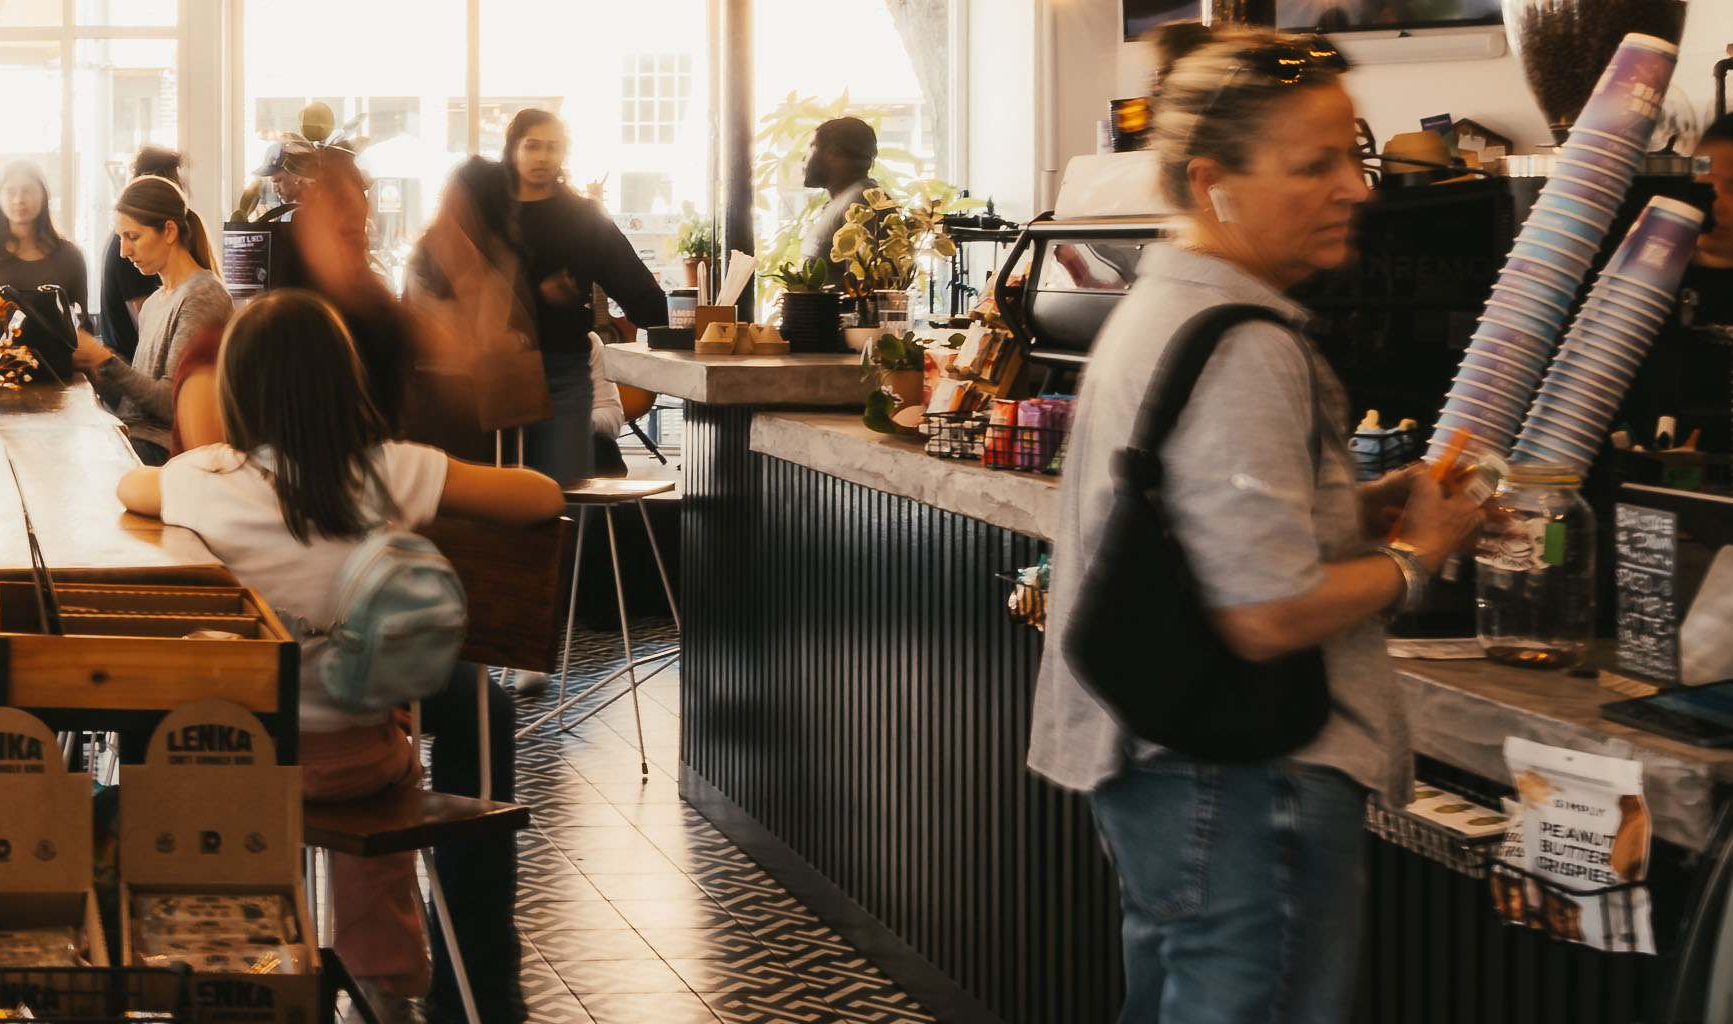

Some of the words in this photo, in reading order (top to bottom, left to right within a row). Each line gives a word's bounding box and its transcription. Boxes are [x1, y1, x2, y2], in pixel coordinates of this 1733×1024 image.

[167, 724, 253, 753] LENKA
[1540, 821, 1618, 849] PEANUT
[1540, 839, 1613, 866] BUTTER
